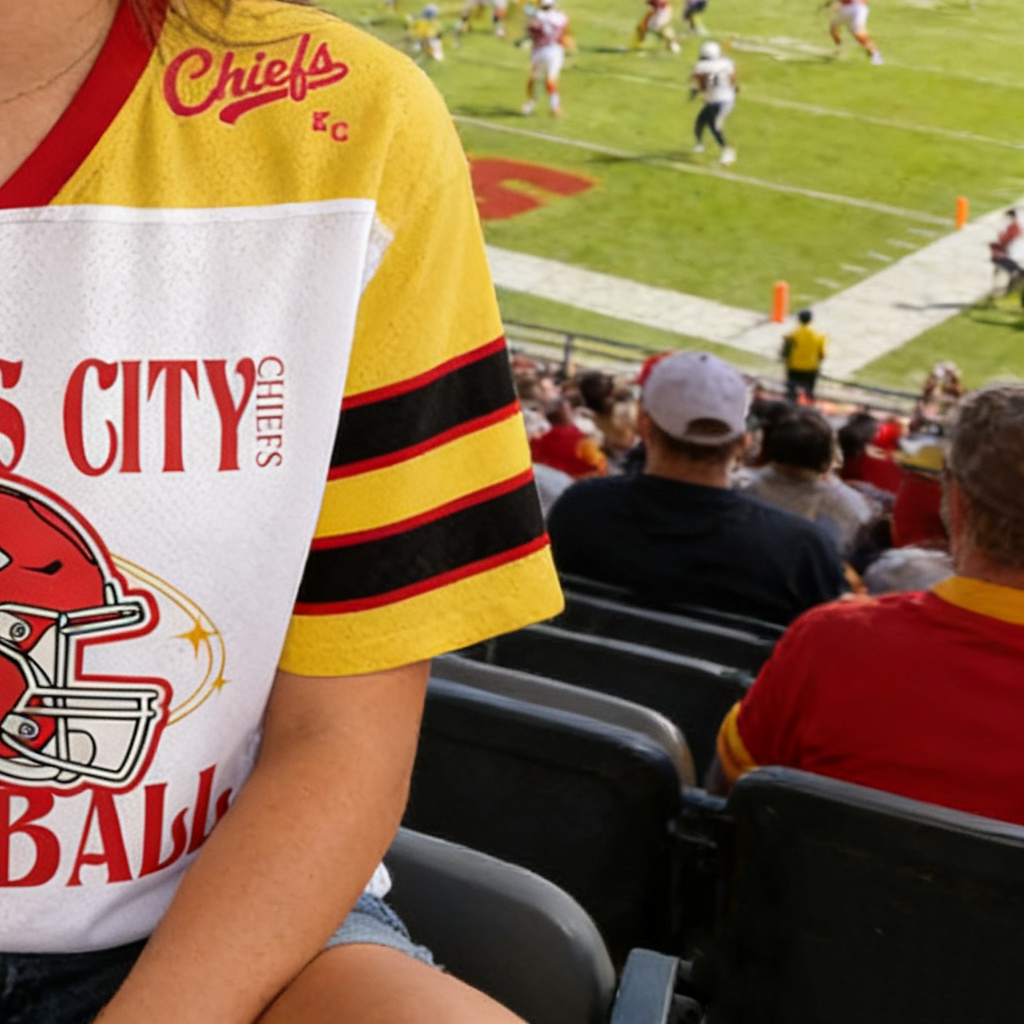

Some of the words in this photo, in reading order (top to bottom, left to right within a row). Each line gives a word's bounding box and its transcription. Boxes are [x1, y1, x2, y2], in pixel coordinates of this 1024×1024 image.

[163, 33, 349, 125] Chiefs
[62, 357, 256, 478] CITY
[255, 356, 284, 468] CHIEFS
